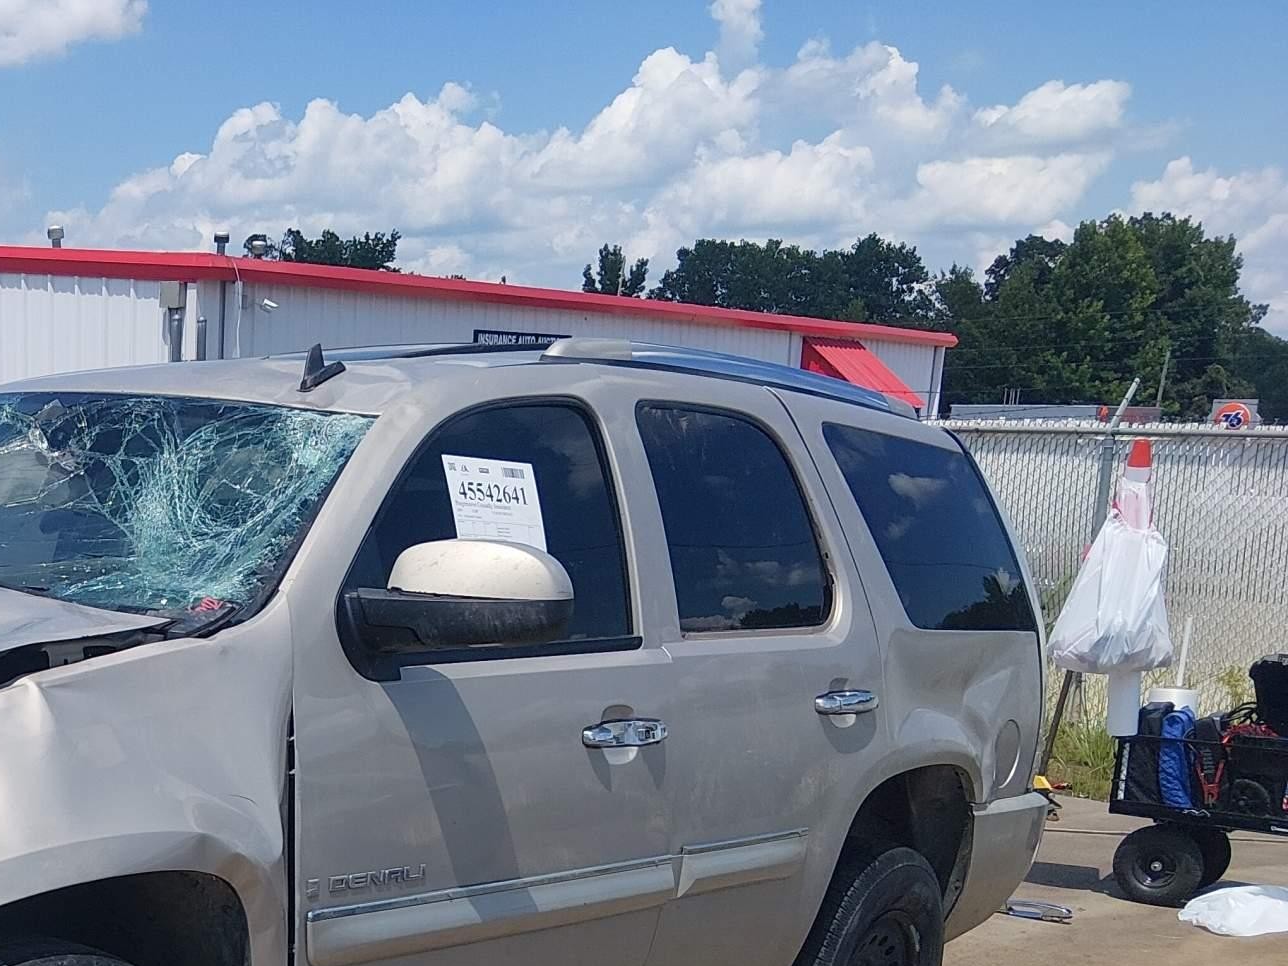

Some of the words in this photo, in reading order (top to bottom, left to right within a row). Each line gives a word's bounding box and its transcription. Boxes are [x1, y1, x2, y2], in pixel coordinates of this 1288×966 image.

[477, 333, 517, 345] INSURANCE
[518, 335, 536, 345] AUTO
[1220, 410, 1244, 429] 76
[458, 481, 529, 506] 45542641
[327, 863, 427, 893] DENALI
